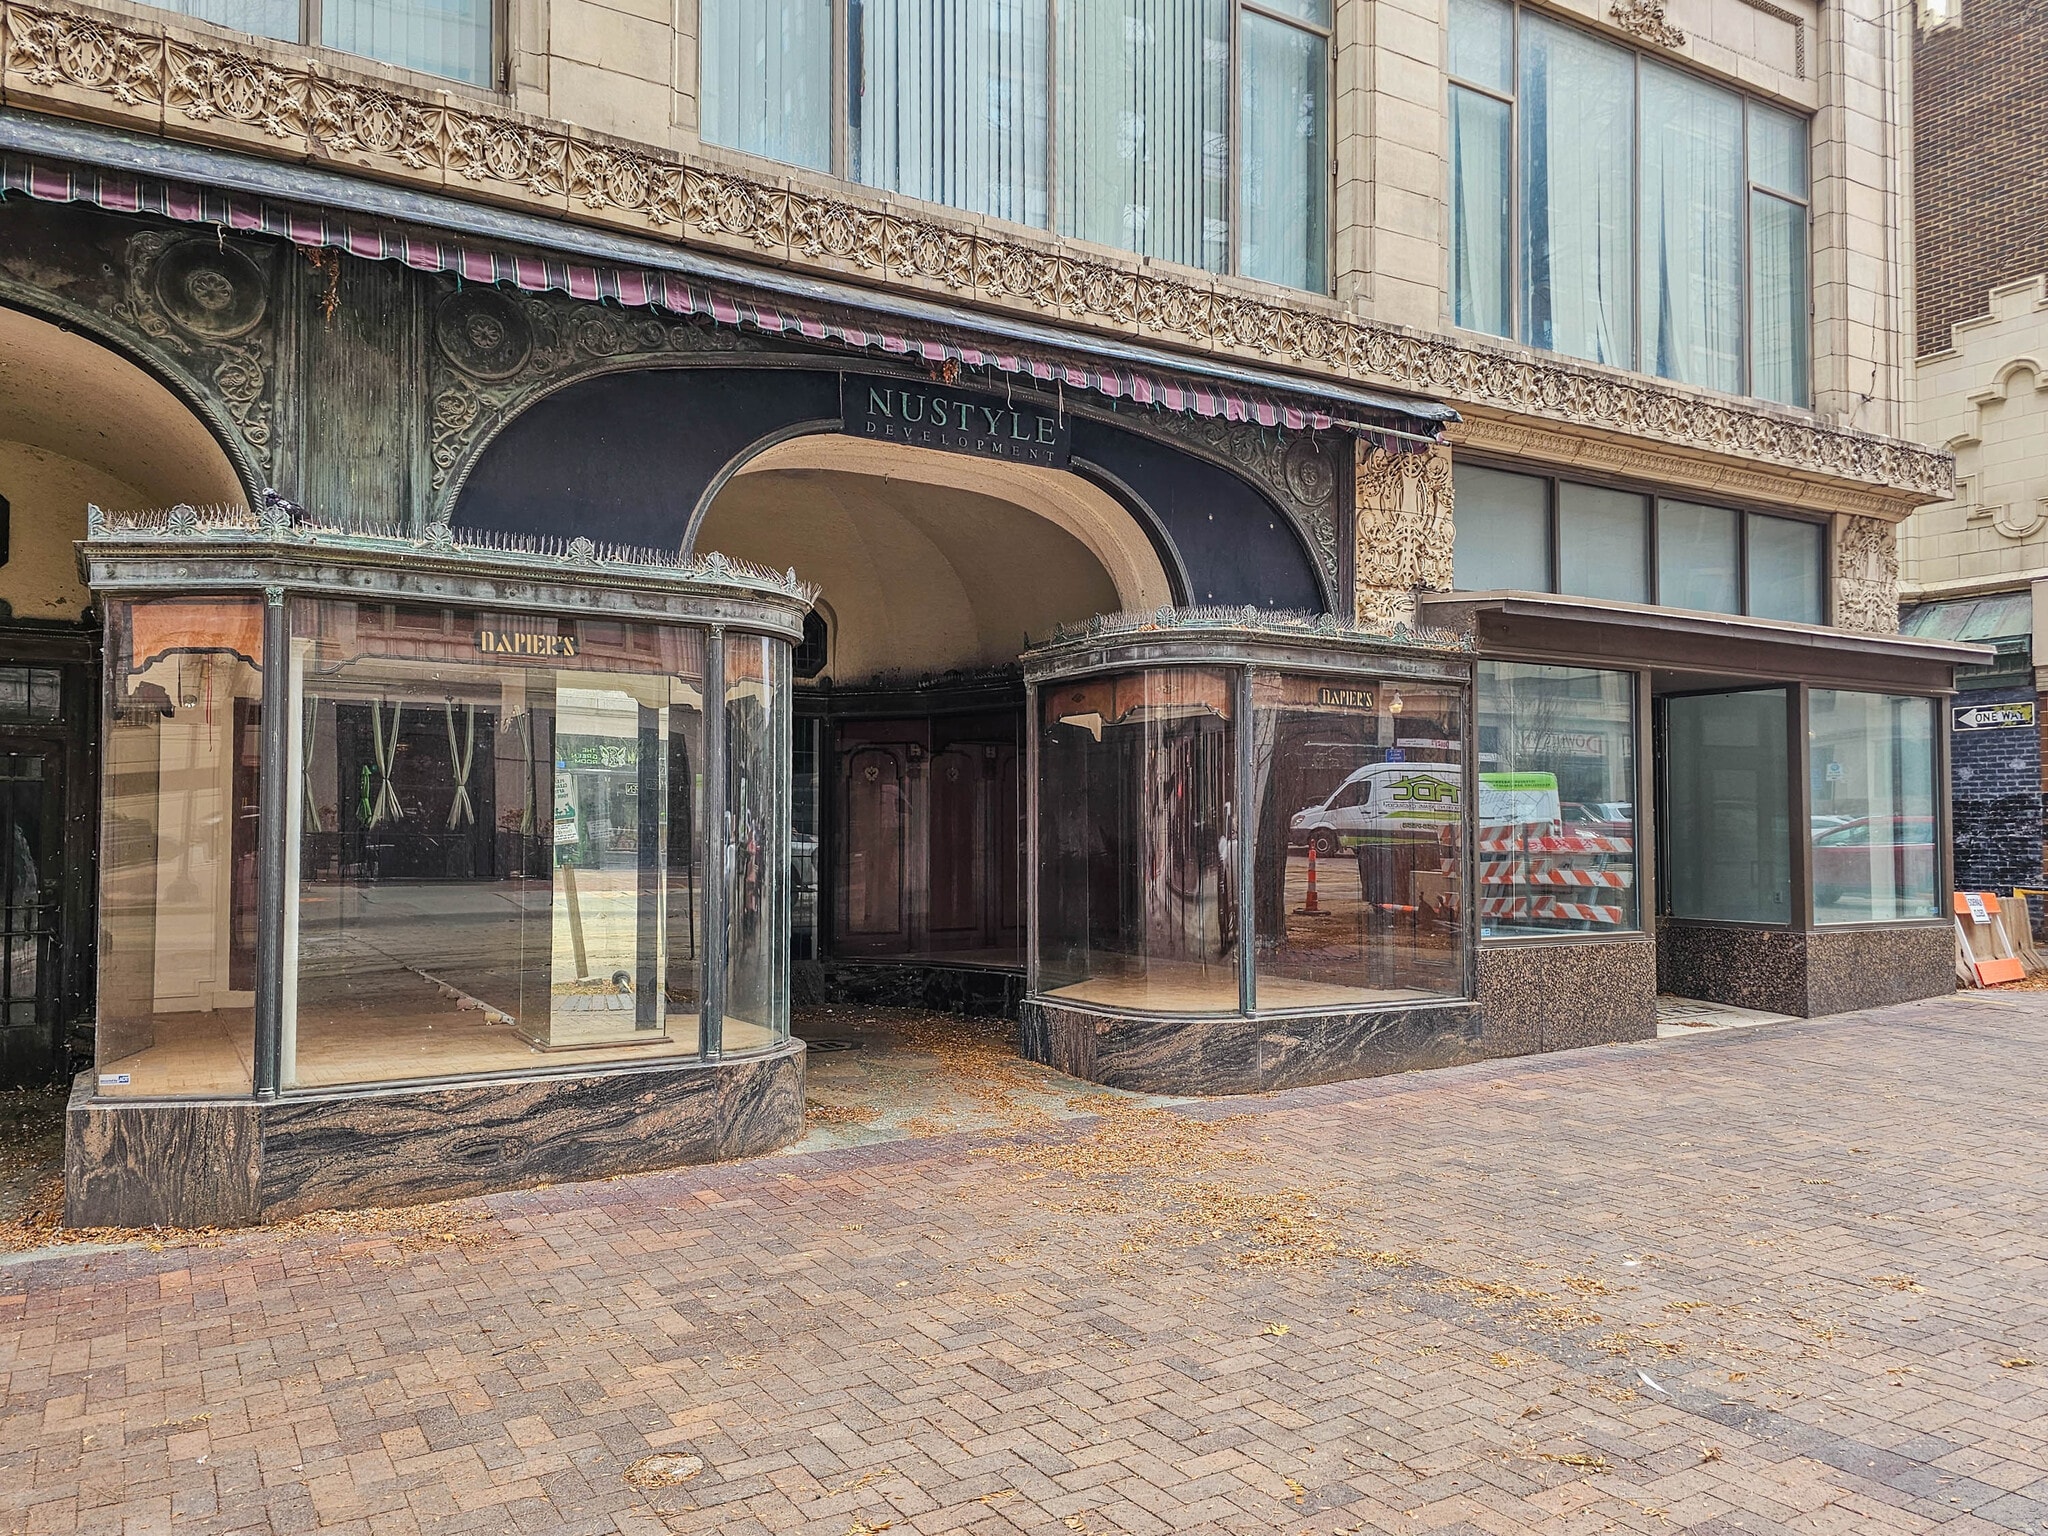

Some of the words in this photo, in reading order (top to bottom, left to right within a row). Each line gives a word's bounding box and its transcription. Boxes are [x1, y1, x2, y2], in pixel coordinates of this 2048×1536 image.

[866, 386, 1057, 446] NUSTYLE
[866, 421, 1055, 462] DEVELOPMENT
[481, 631, 574, 657] NAPIER'S
[1322, 688, 1373, 707] NAPIER'S
[1975, 712, 1999, 723] ONE
[2001, 710, 2024, 721] WAY
